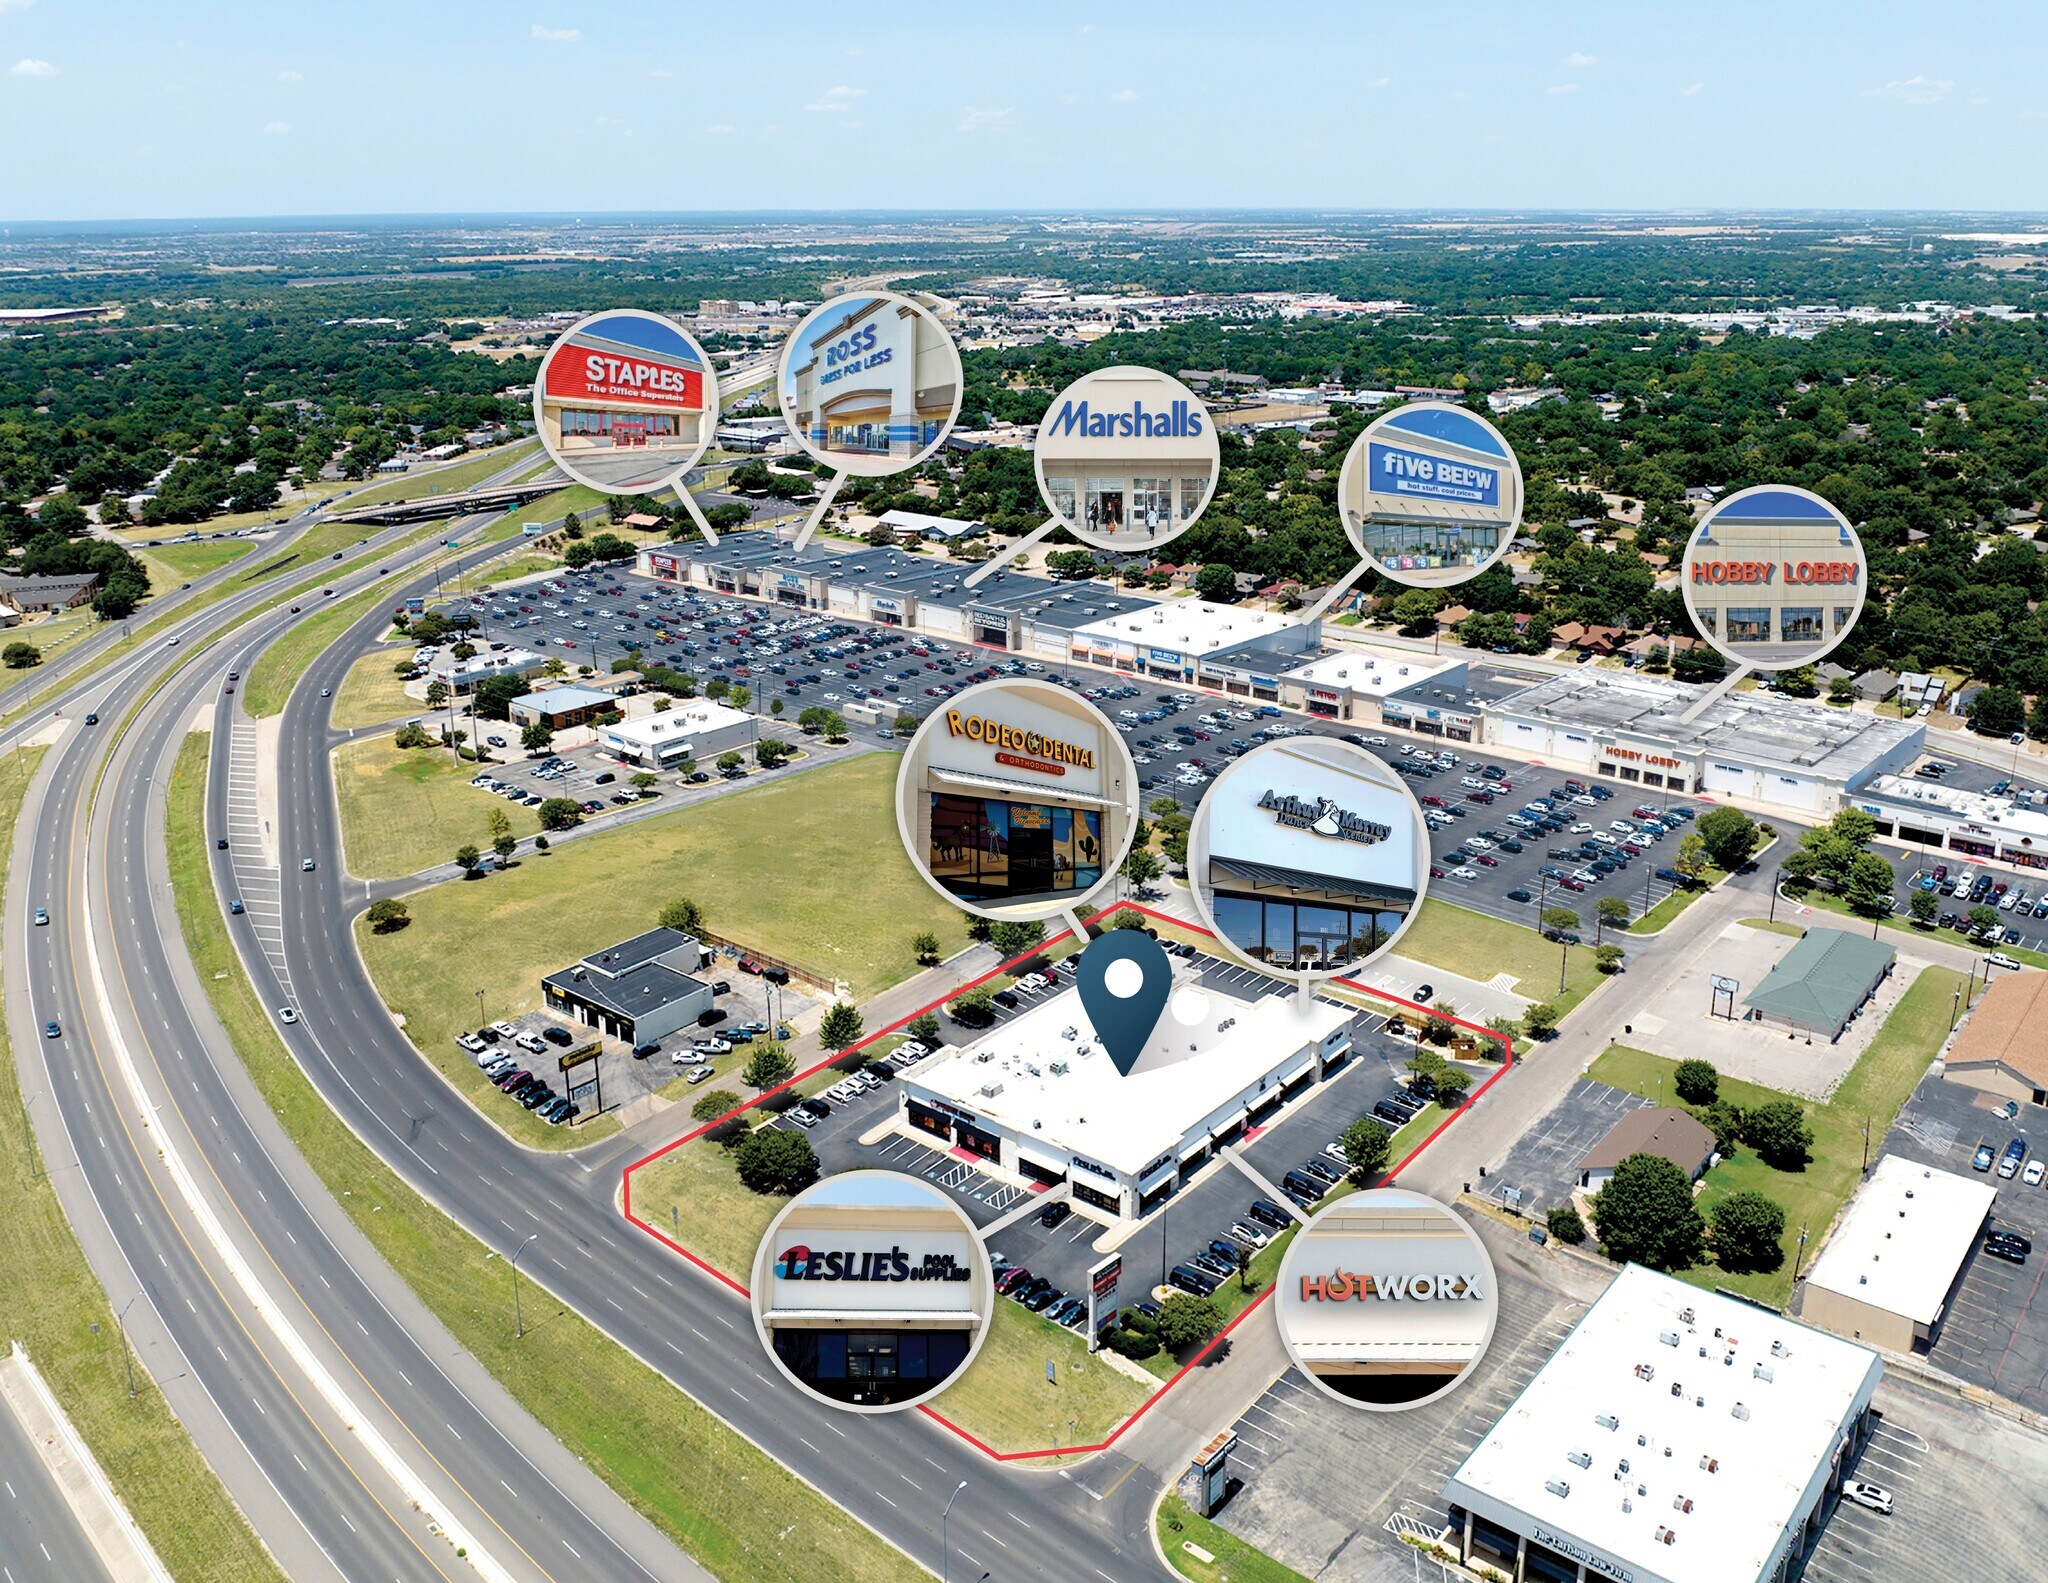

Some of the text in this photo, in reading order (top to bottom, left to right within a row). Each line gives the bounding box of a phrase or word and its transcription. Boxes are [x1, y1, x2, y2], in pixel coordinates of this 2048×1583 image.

[827, 323, 877, 367] ROSS
[585, 355, 685, 392] STAPLES
[844, 360, 862, 377] FOR
[864, 347, 893, 370] LESS
[585, 383, 684, 402] The Office Superstore
[1048, 400, 1203, 437] Marshalls
[1383, 452, 1434, 479] five
[1407, 482, 1420, 490] hot
[1441, 487, 1456, 495] cool
[1691, 561, 1858, 583] HOBBY LOBBY
[946, 709, 1097, 769] RODEO DENTAL
[1009, 757, 1065, 775] ORTHODONTICS
[1606, 746, 1681, 770] HOBBY LOBBY
[1257, 788, 1392, 842] Arthur Murray
[1276, 812, 1376, 845] Dance Centers
[784, 1246, 910, 1282] LESLIE'S
[910, 1267, 971, 1282] SUPPLIES
[923, 1254, 957, 1268] POOL
[1302, 1266, 1484, 1301] HOTWORX
[1533, 1526, 1550, 1544] The
[1588, 1553, 1607, 1571] Law
